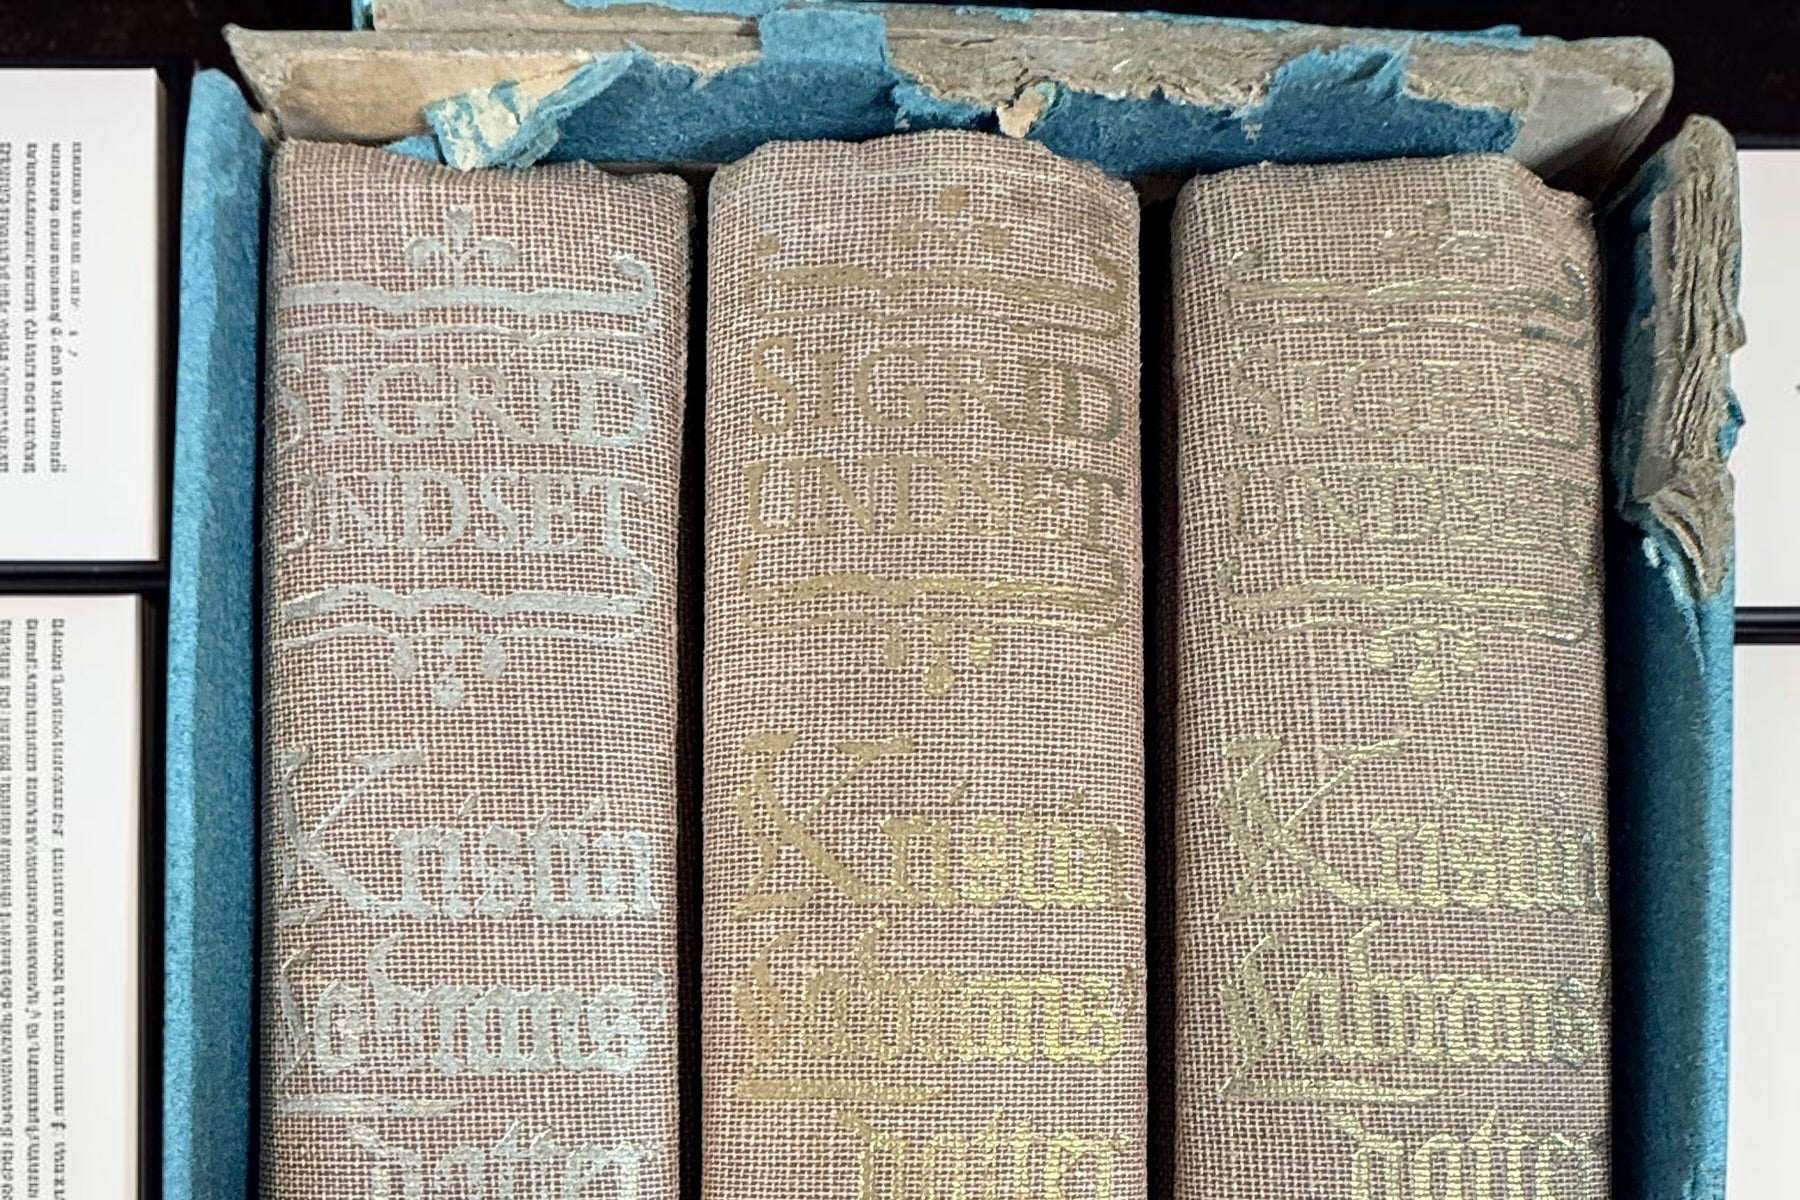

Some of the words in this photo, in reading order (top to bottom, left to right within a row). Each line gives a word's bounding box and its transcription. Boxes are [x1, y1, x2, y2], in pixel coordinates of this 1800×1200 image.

[274, 350, 656, 448] SIGRID
[750, 335, 1122, 442] SIGRID
[1230, 345, 1588, 450] SIGRID
[743, 455, 1124, 556] UNDSET
[1222, 465, 1594, 558] UNDSET
[731, 732, 1131, 920] Kristin
